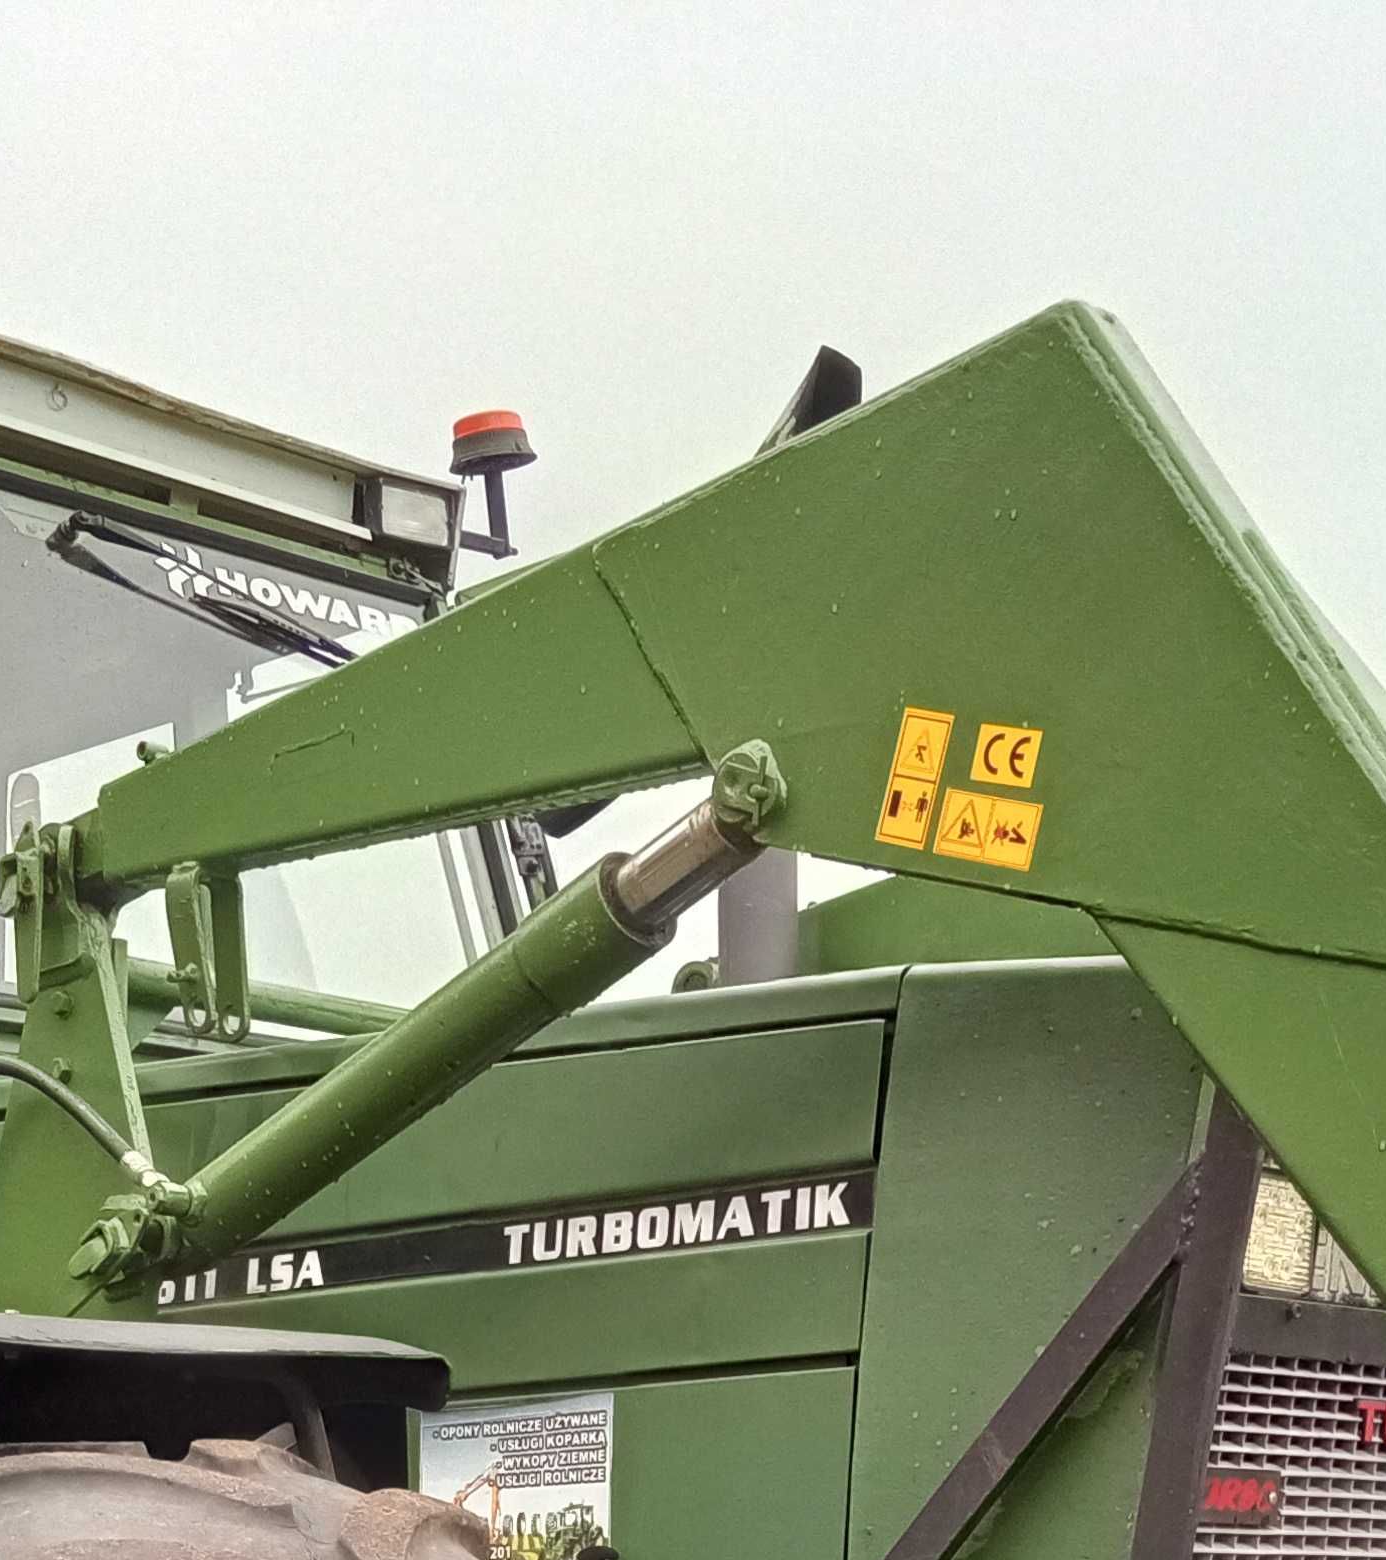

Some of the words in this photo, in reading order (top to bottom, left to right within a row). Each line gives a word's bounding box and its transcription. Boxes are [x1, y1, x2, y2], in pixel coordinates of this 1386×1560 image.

[215, 567, 421, 634] HOWARD
[983, 733, 1032, 779] CE
[503, 1182, 850, 1265] TURBOMATIK
[246, 1250, 325, 1295] LSA
[440, 1425, 480, 1439] OPONY
[483, 1419, 542, 1435] ROLNICZE
[545, 1411, 606, 1430] UŻYWANE
[499, 1438, 543, 1451] USŁUGI
[503, 1453, 556, 1469] WYKOPY
[558, 1450, 606, 1464] ZIEMNE
[497, 1472, 541, 1486] USŁUGI
[545, 1468, 605, 1484] ROLNICZE
